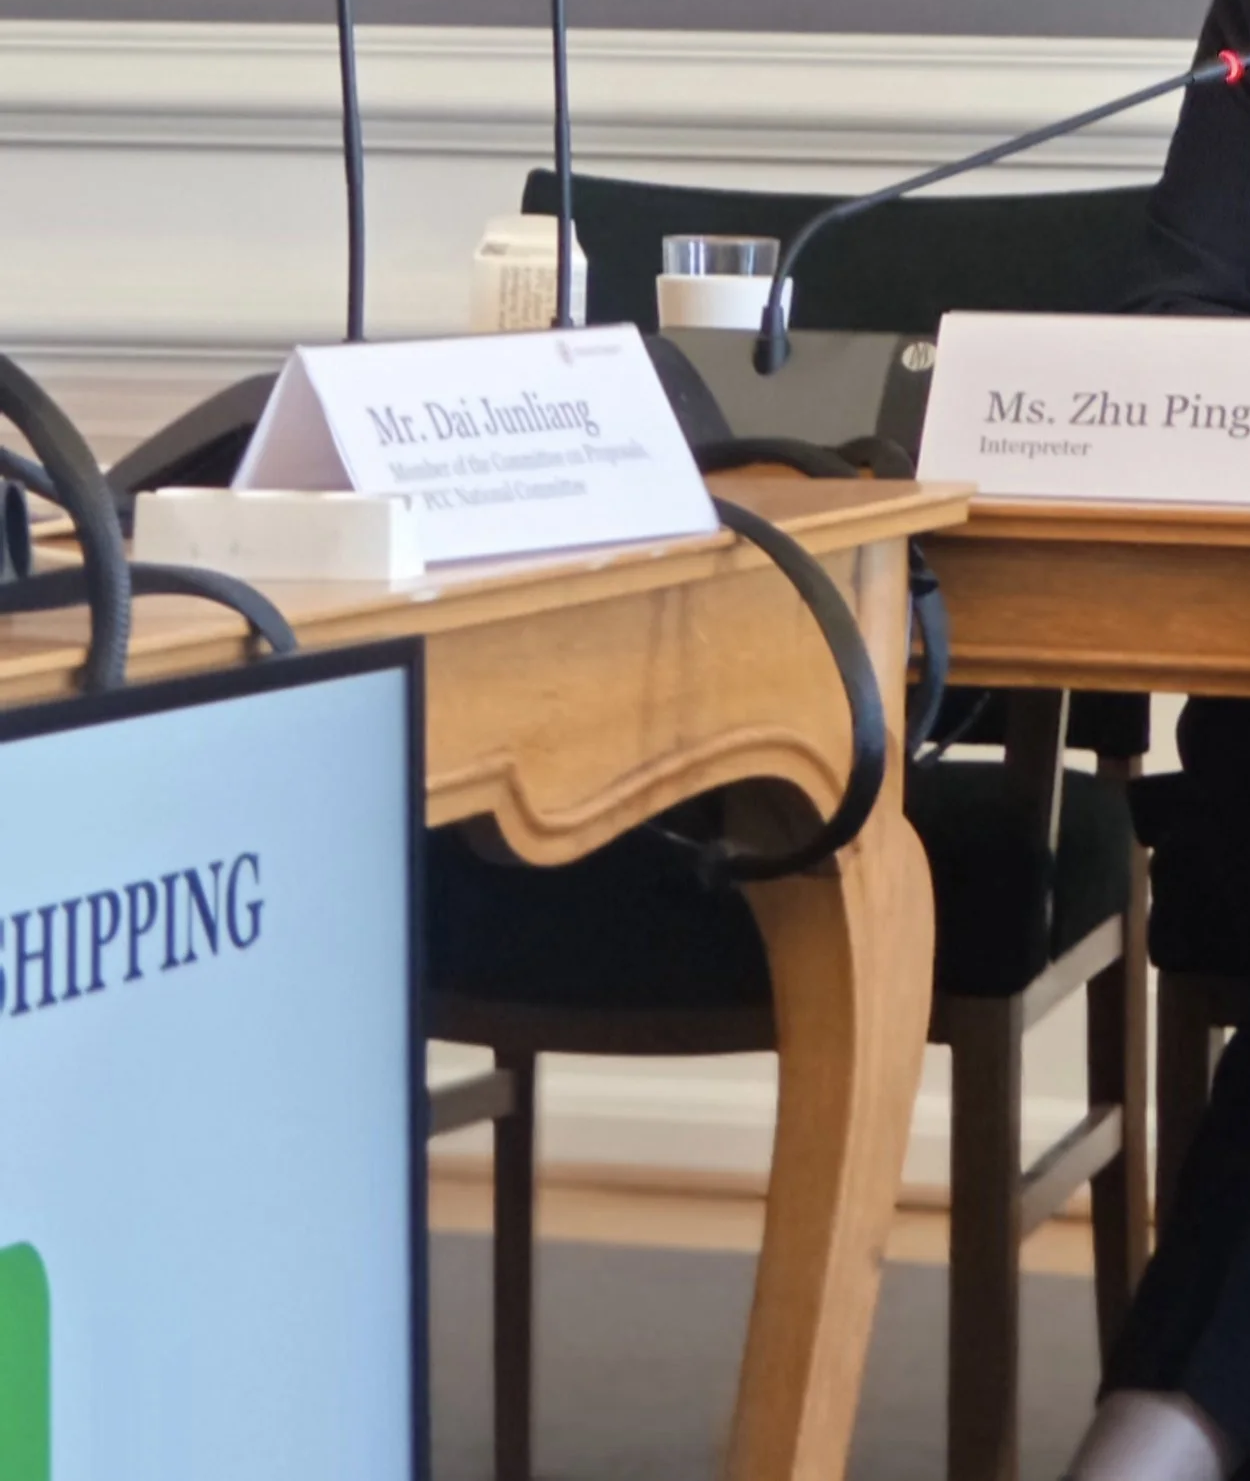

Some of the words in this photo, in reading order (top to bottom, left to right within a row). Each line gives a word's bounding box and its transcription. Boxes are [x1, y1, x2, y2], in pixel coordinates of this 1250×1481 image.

[366, 406, 427, 447] Mr.
[424, 398, 481, 441] Dai
[480, 391, 600, 437] Junliang
[983, 389, 1055, 424] Ms.
[1068, 390, 1149, 428] Zhu
[978, 435, 1092, 459] Interpreter
[389, 454, 450, 484] Member
[489, 448, 566, 472] Committee
[453, 480, 515, 508] National
[513, 476, 588, 501] Committee
[0, 851, 265, 1018] HIPPING
